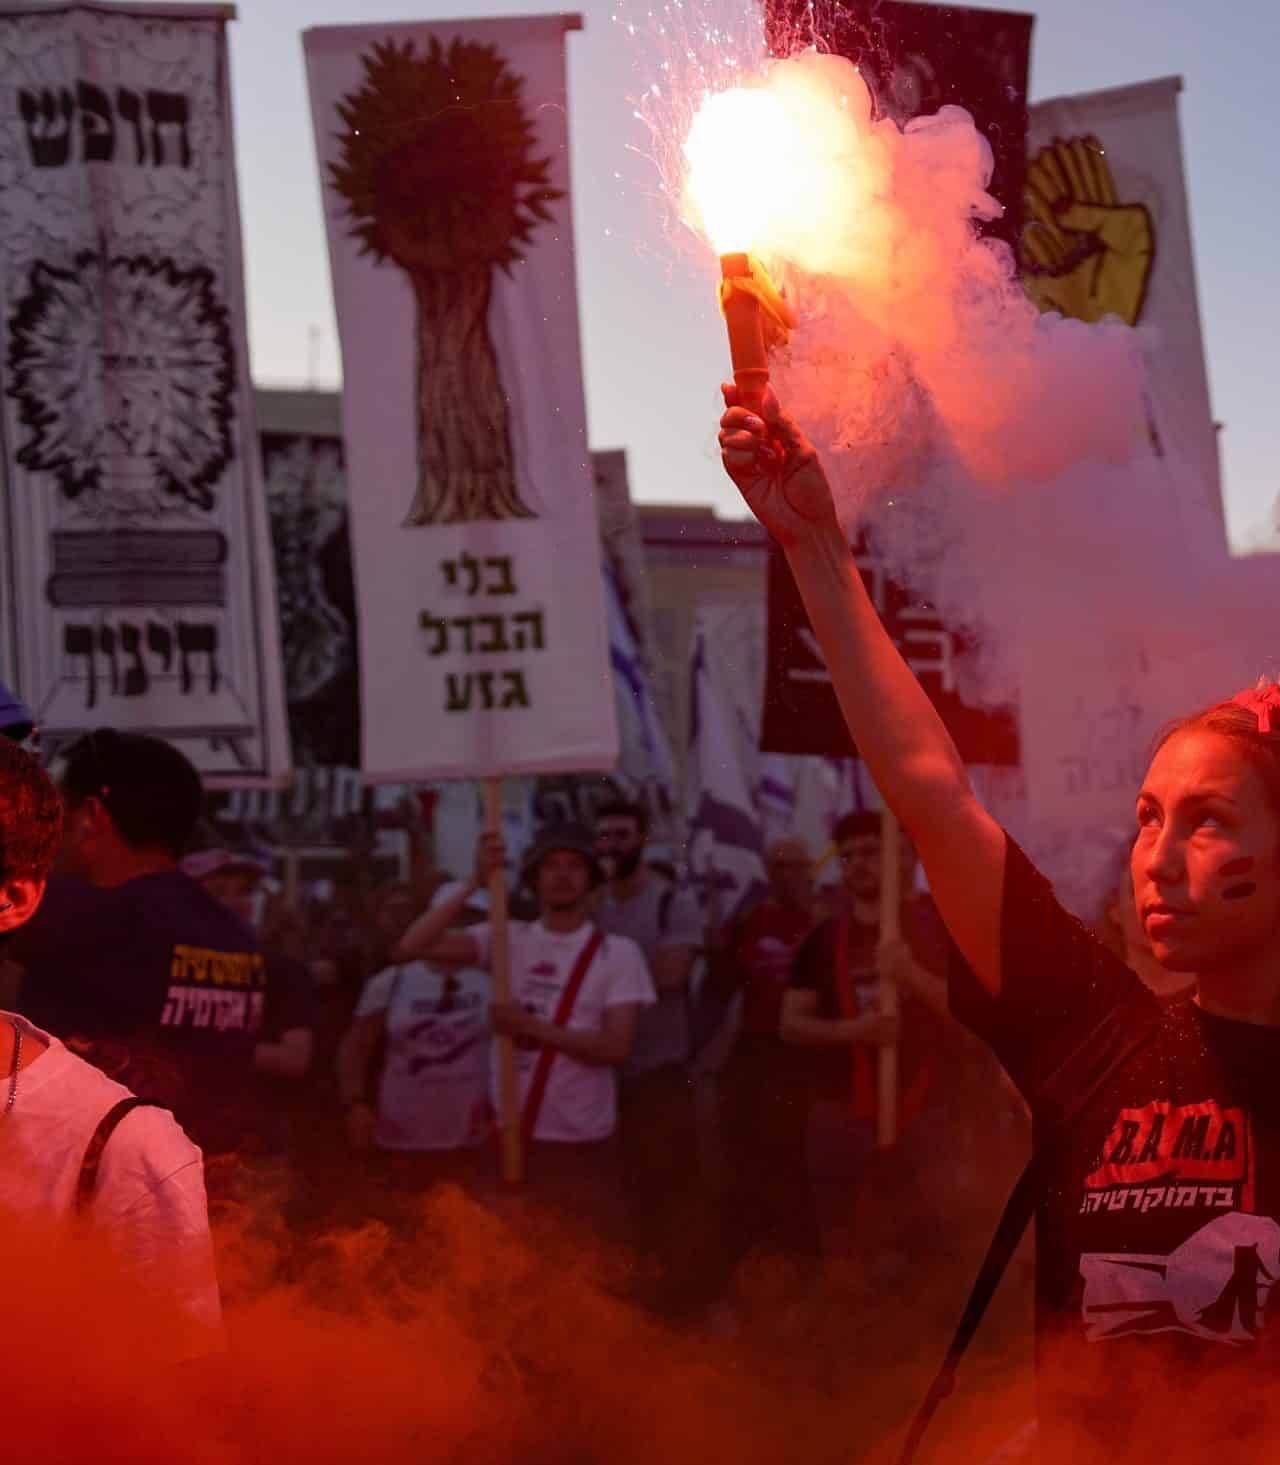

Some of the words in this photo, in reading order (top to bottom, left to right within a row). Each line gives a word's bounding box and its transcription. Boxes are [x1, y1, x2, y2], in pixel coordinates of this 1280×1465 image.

[18, 79, 191, 168] חופש
[442, 551, 517, 598] בלי
[419, 609, 544, 657] הבדל
[64, 622, 218, 709] חינוך
[444, 671, 530, 714] גזע
[1079, 1186, 1234, 1214] בדמוקרטיה!
